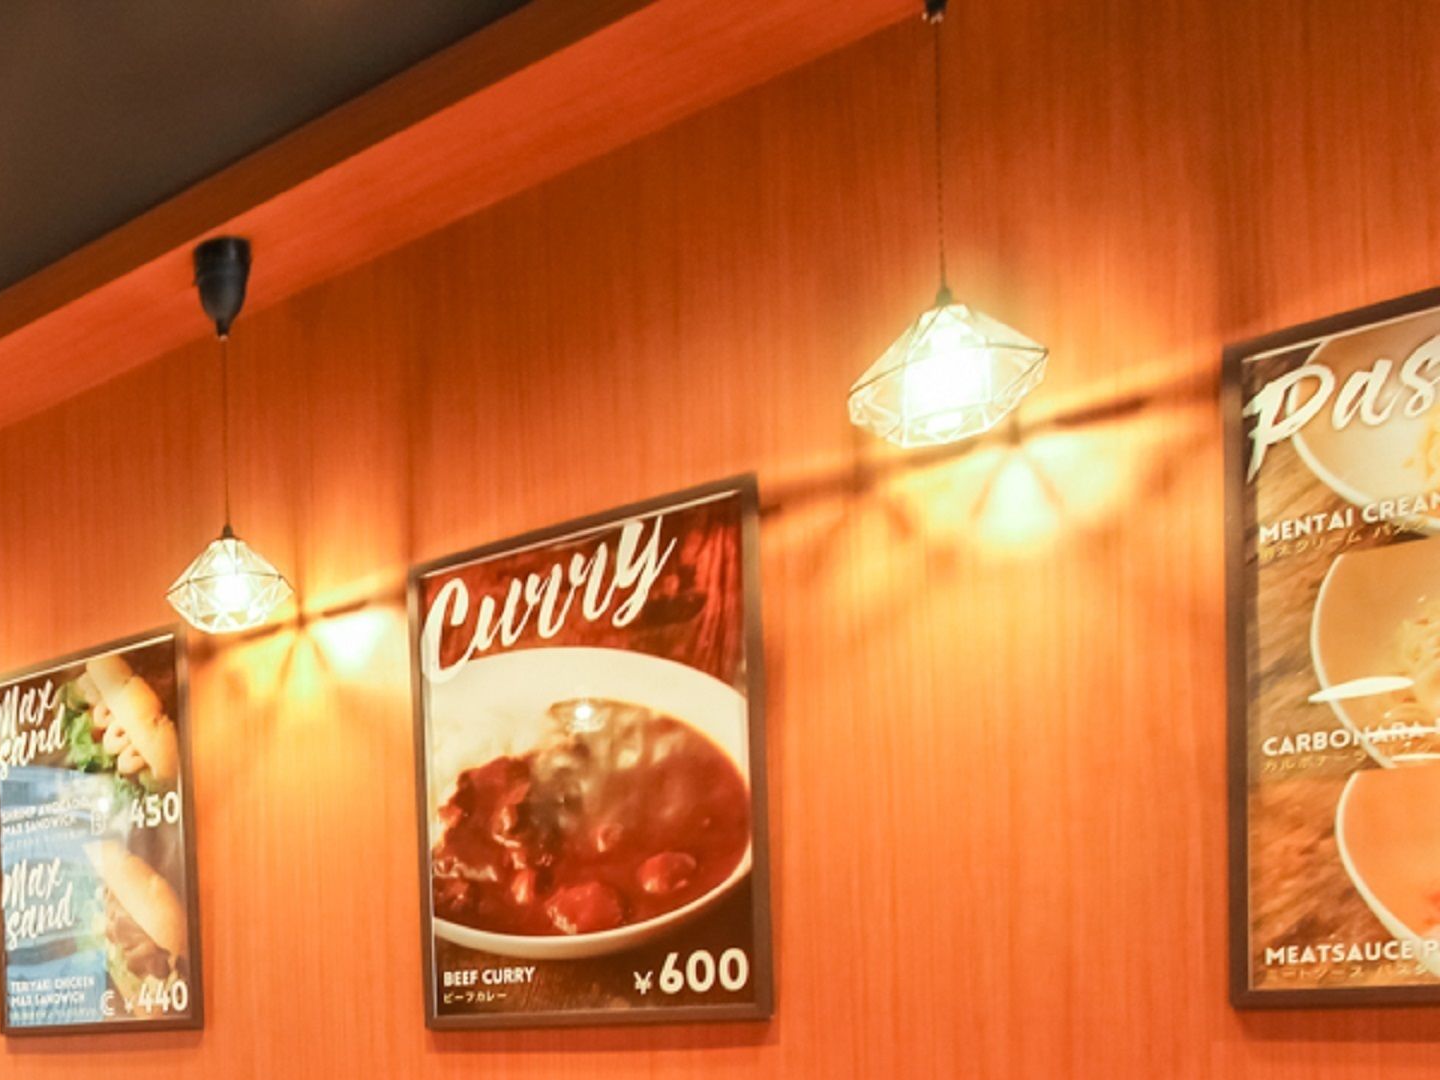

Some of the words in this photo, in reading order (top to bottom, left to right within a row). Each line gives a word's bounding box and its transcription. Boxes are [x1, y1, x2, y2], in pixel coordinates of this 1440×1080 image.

[1259, 508, 1354, 544] MENTAI
[421, 514, 678, 685] Curry
[129, 791, 180, 829] 450
[2, 857, 62, 910] Max
[633, 947, 749, 995] ¥600
[1265, 940, 1413, 965] MEATSAUCE
[443, 970, 478, 987] BEEF
[481, 966, 536, 985] CURRY
